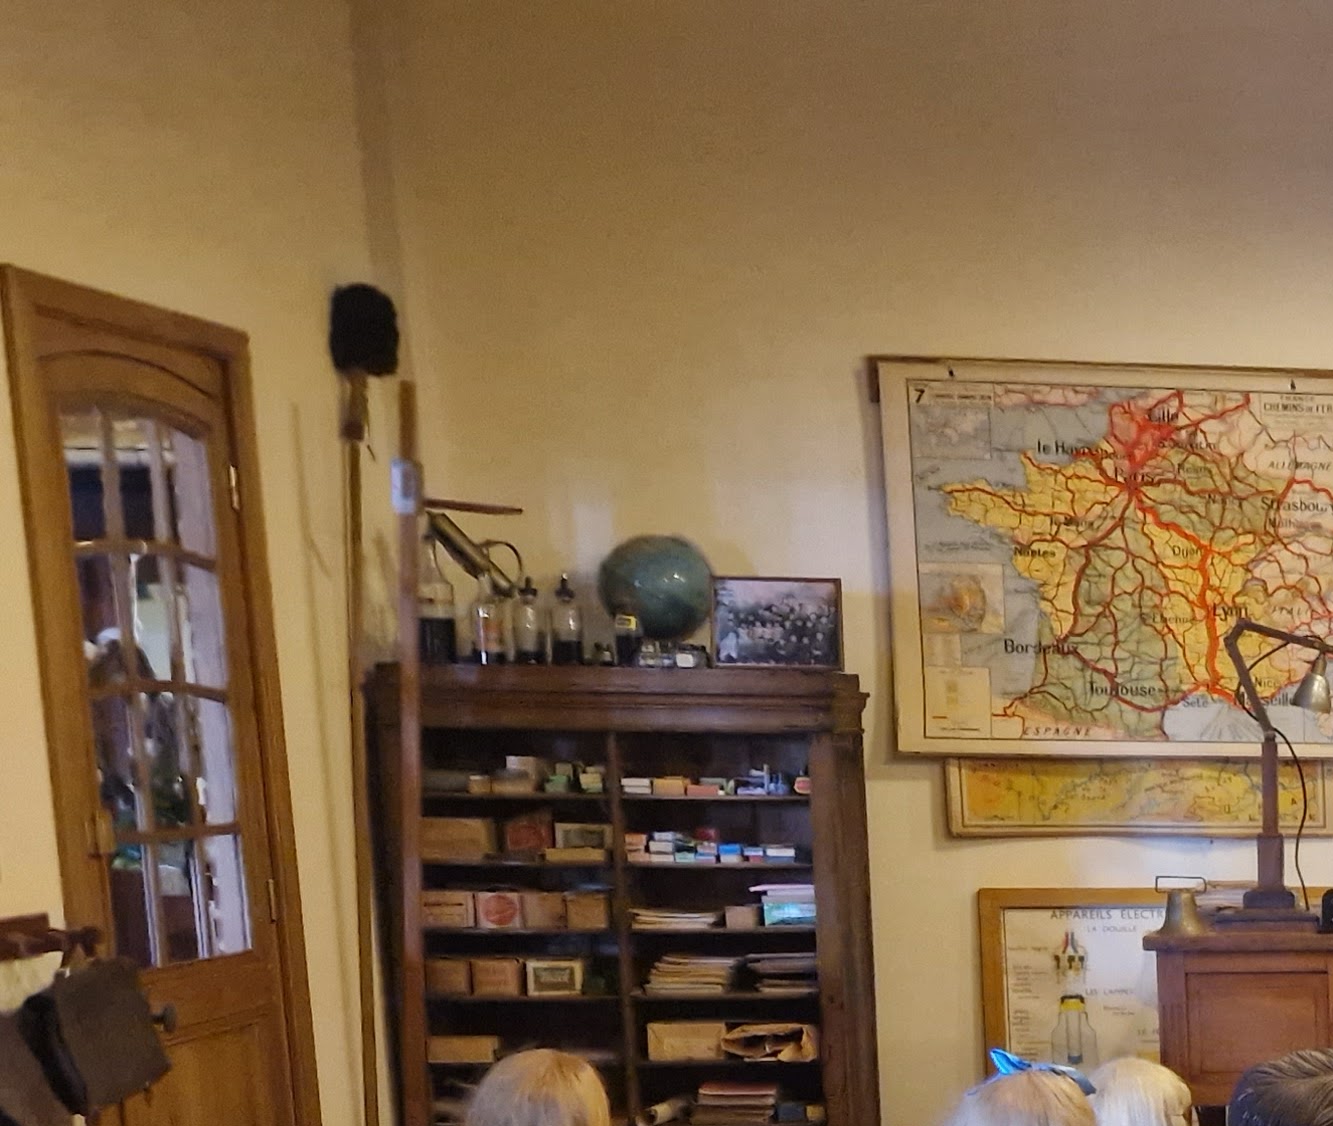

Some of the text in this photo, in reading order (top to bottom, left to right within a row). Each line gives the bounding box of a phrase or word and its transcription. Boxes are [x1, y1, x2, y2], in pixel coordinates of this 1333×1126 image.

[914, 388, 926, 404] 7
[1263, 402, 1305, 413] CHEMINS
[1316, 403, 1333, 414] FER
[1003, 638, 1079, 656] Bordeaux
[1089, 681, 1157, 698] Toulouse
[1022, 725, 1092, 737] ESPAGNE
[1050, 909, 1113, 920] APPAREILS
